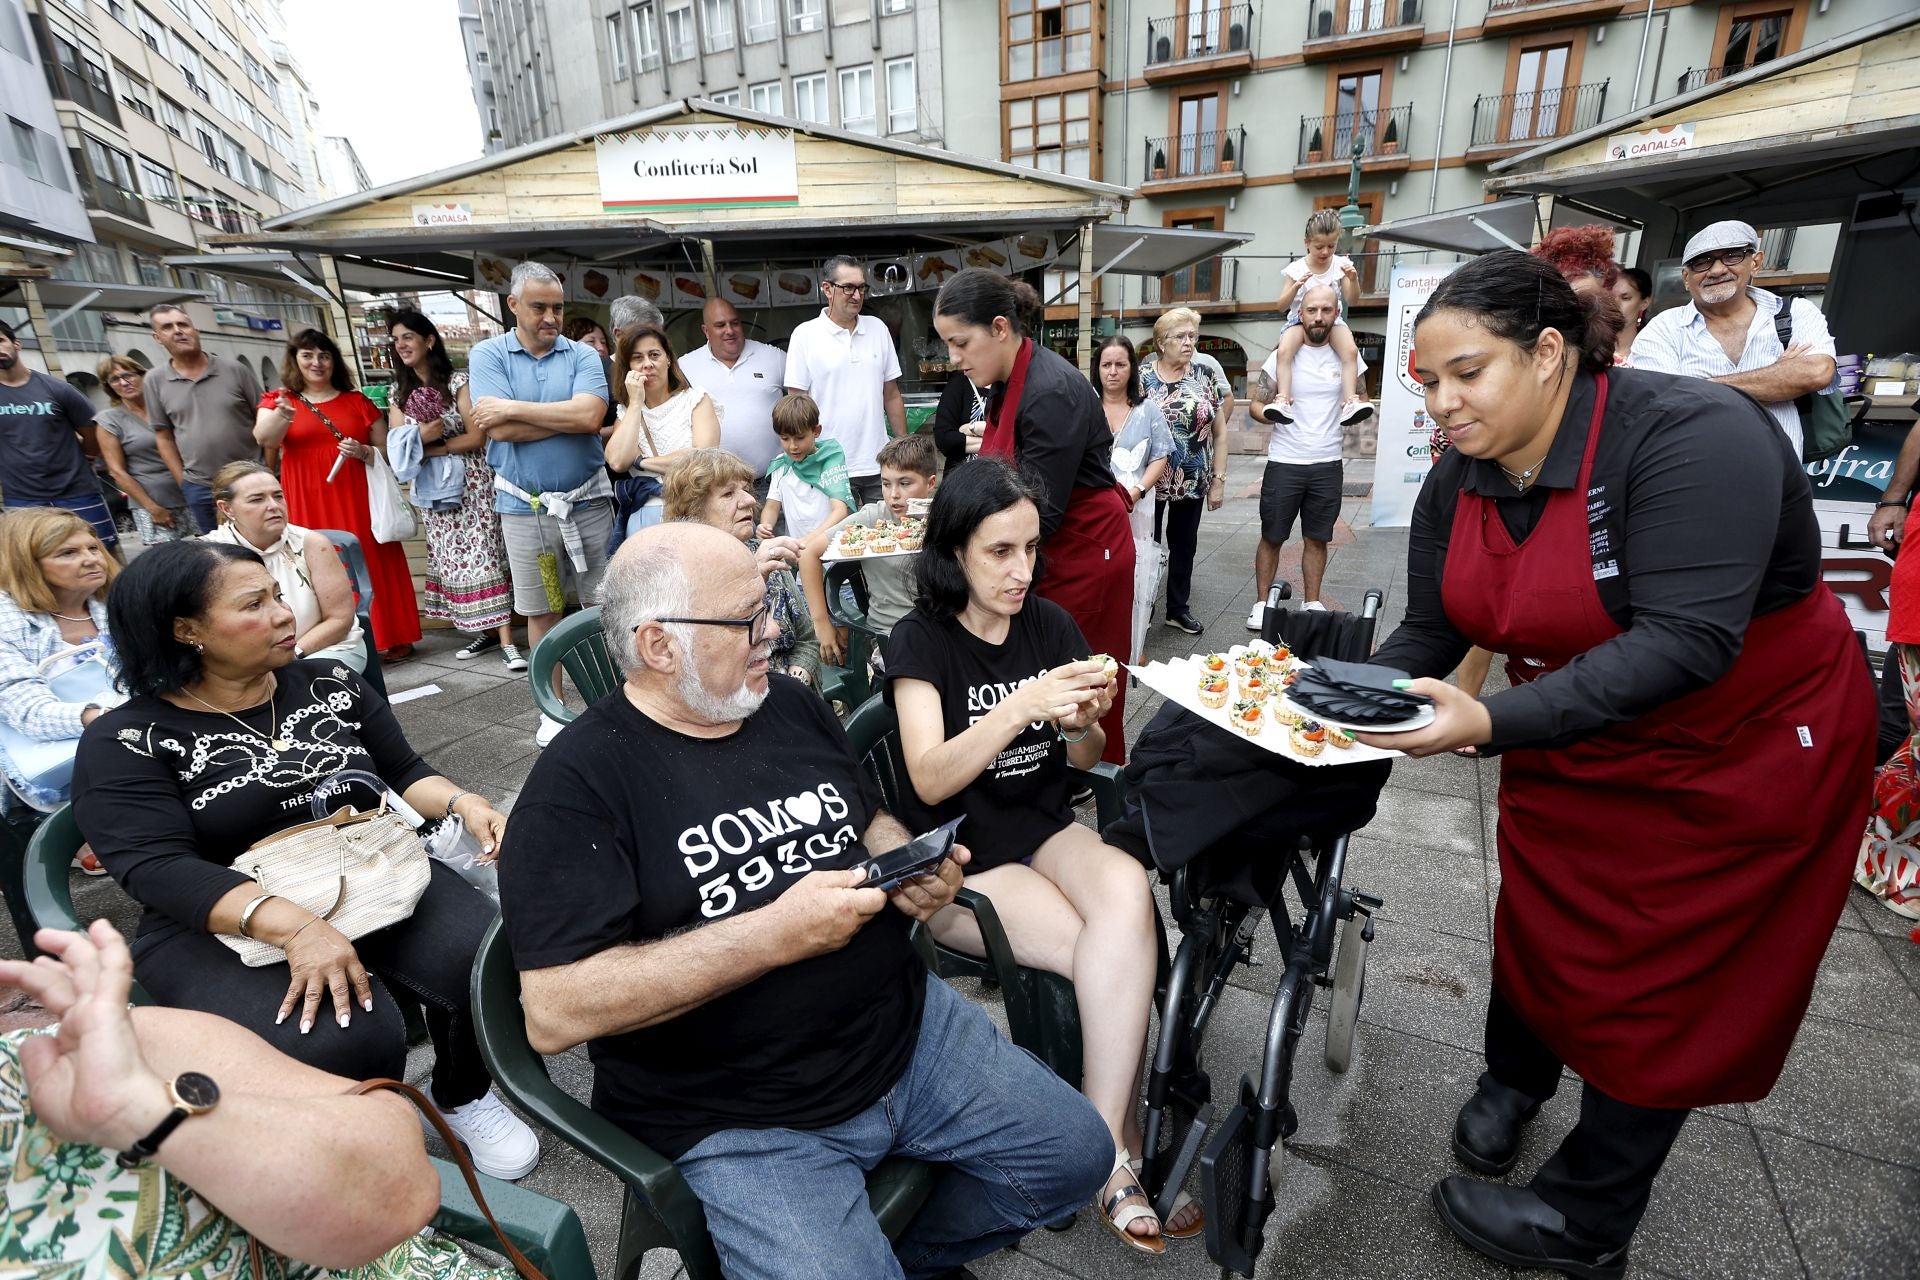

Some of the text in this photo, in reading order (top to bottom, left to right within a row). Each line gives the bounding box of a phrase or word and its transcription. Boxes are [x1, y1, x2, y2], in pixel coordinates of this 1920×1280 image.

[1631, 137, 1687, 154] CANALSA
[634, 156, 758, 178] Confitería Sol
[431, 214, 468, 223] CANALSA
